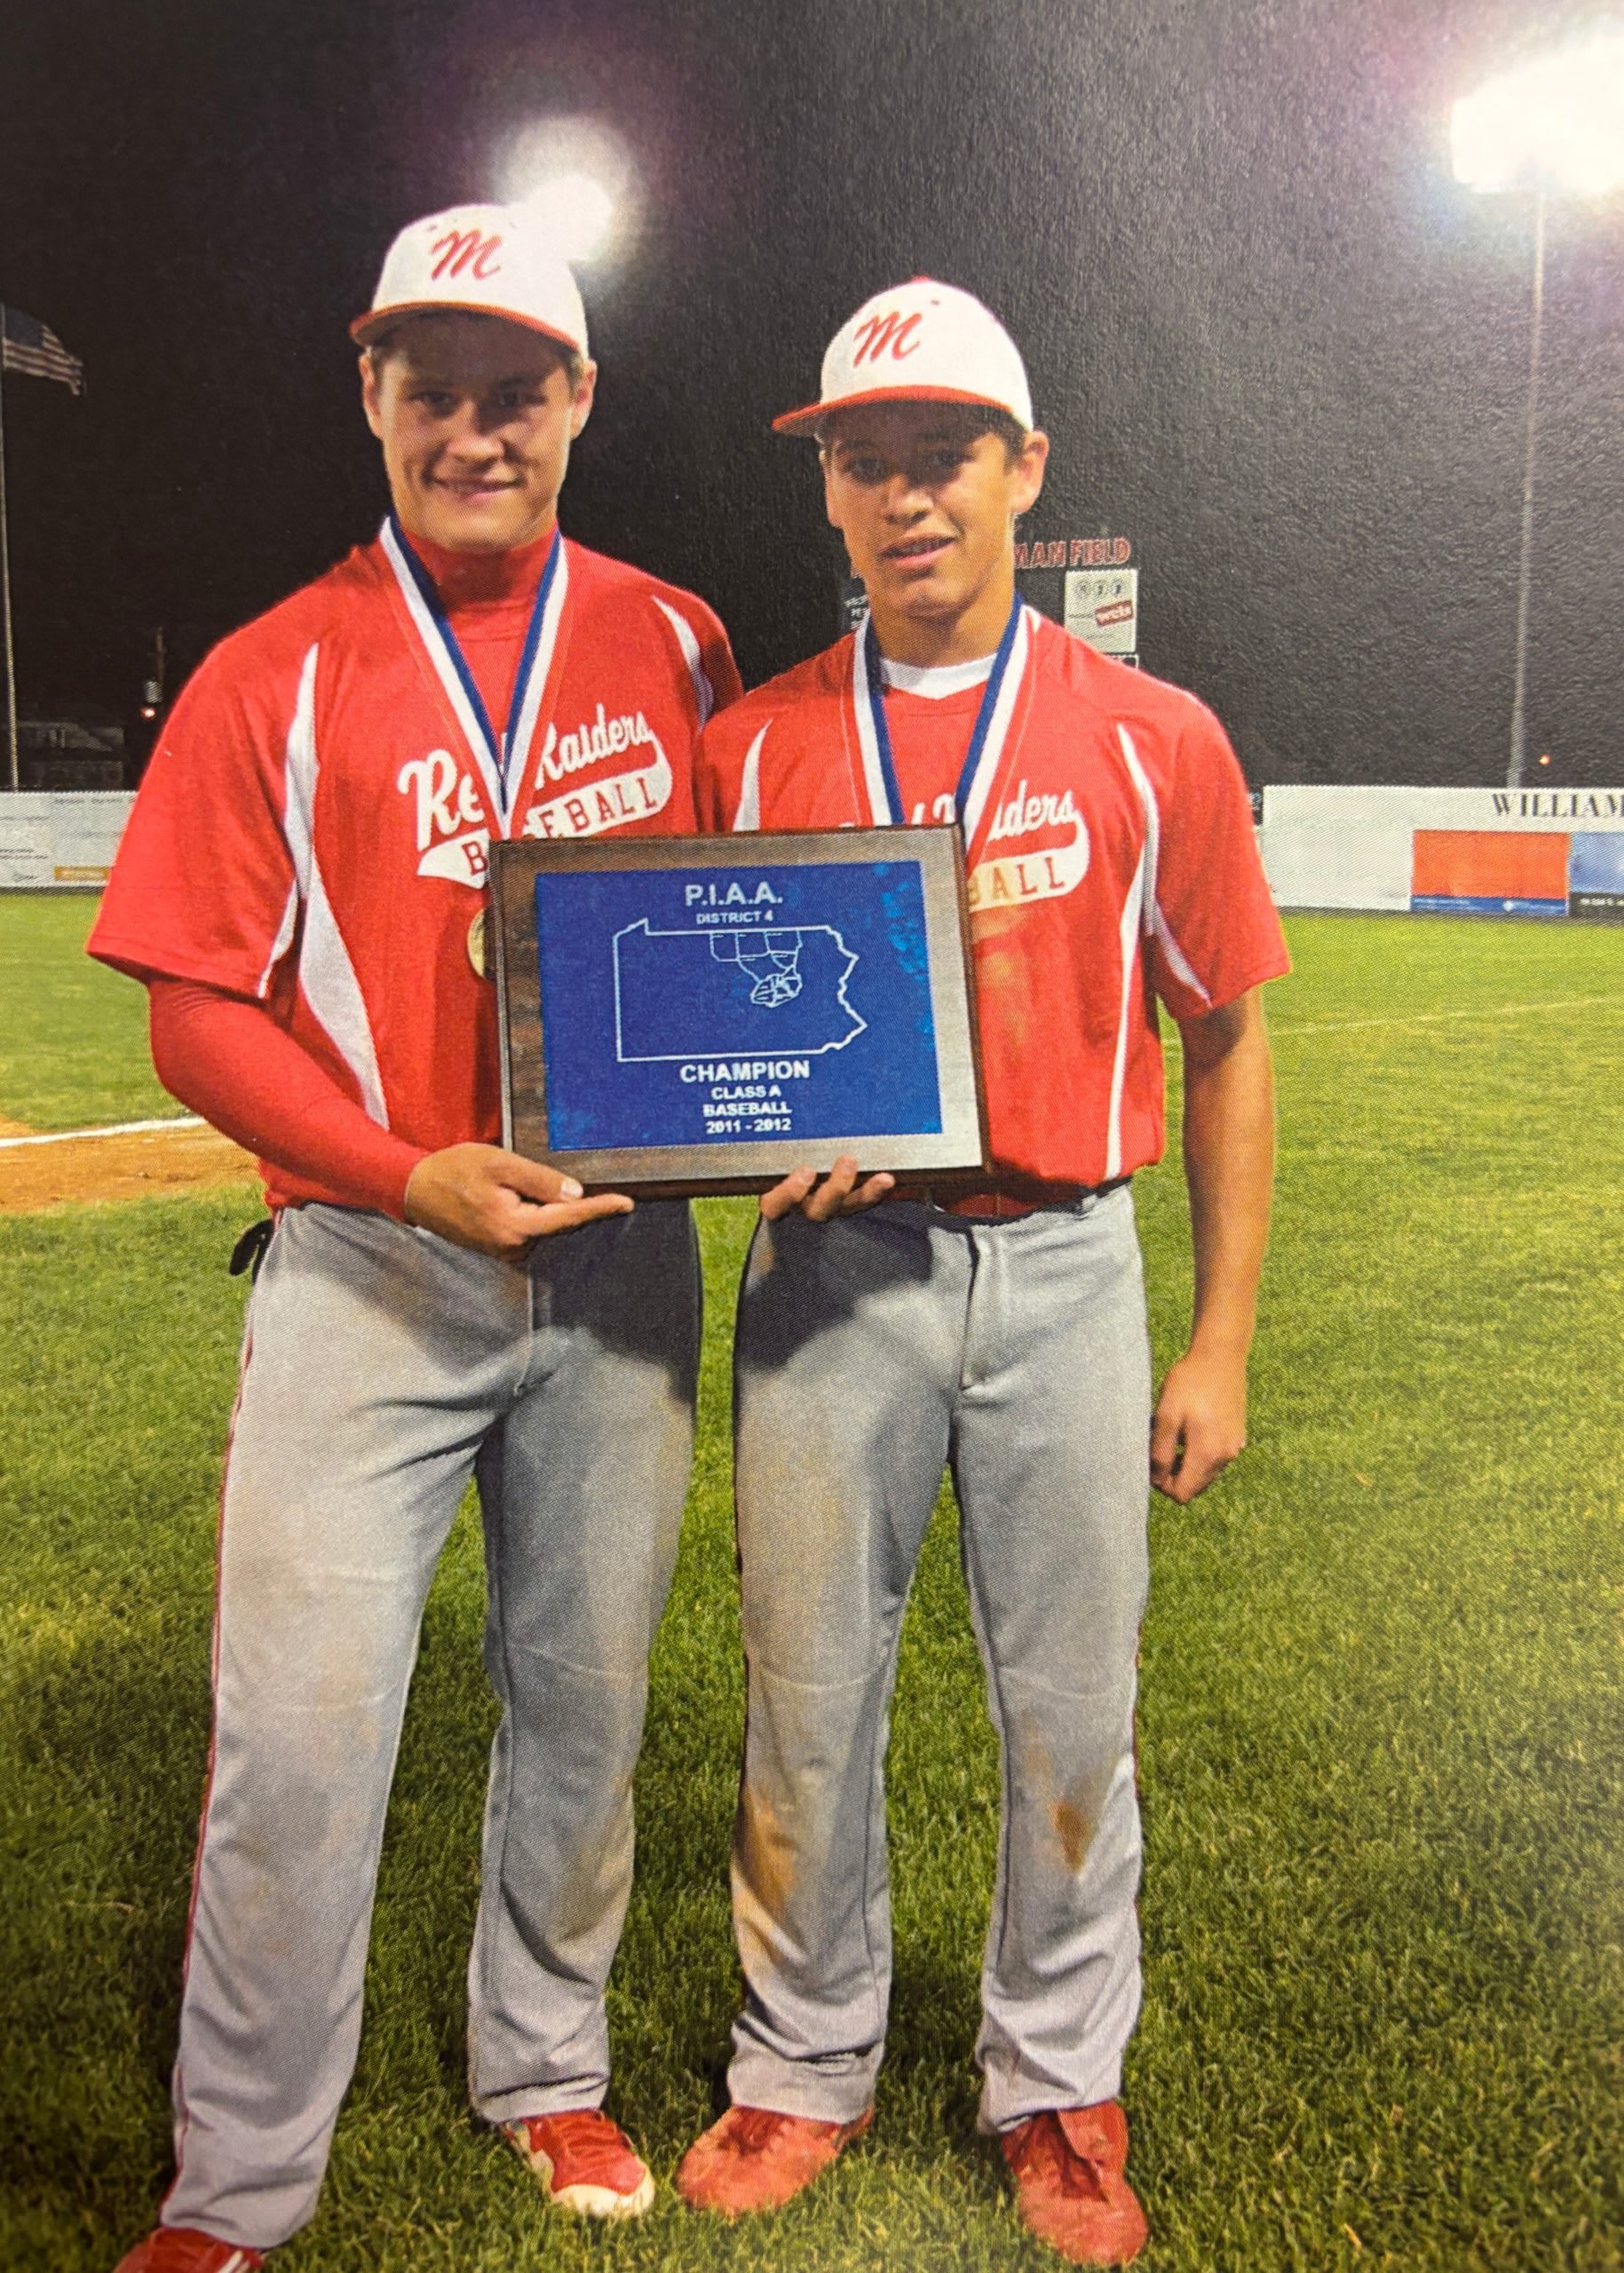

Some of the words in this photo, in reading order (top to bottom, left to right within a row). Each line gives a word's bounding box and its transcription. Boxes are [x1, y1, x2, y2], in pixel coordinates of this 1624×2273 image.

[430, 228, 503, 281] M
[853, 311, 922, 368] M
[1014, 541, 1066, 569] MAN
[1070, 537, 1131, 566] FIELD
[398, 733, 508, 851] Re
[462, 776, 659, 875] BEBALL
[685, 881, 783, 907] P.I.A.A.
[696, 911, 762, 924] DISTRICT
[764, 909, 774, 923] 4
[680, 1060, 811, 1083] CHAMPION
[711, 1085, 766, 1101] CLASS
[768, 1084, 782, 1098] A
[702, 1101, 793, 1118] BASEBALL
[705, 1120, 741, 1135] 2011
[753, 1117, 792, 1133] 2012
